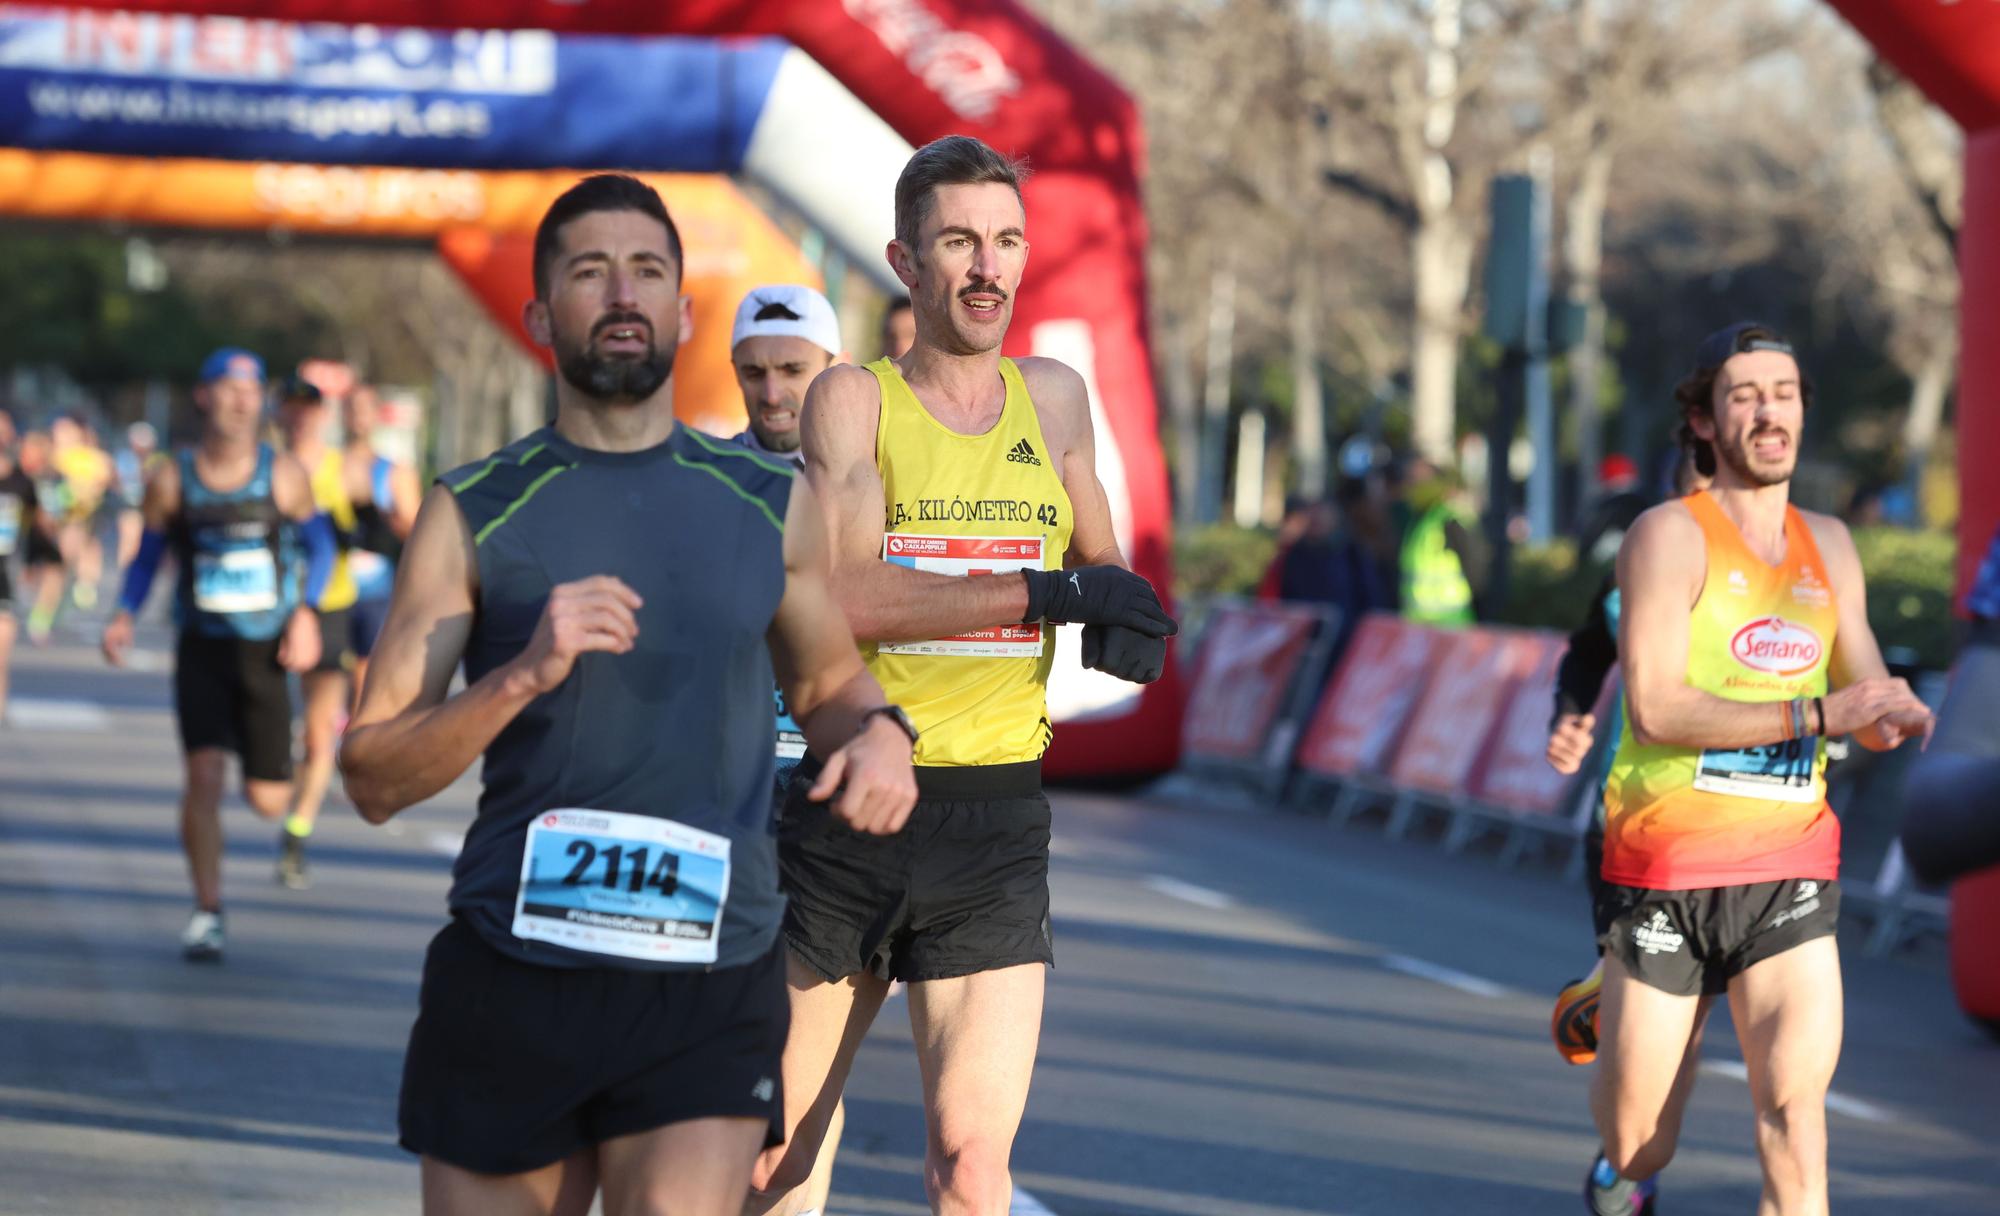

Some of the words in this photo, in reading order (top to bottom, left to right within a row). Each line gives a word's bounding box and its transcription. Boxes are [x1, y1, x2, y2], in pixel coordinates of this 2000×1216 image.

[1006, 453, 1041, 466] adidas
[885, 503, 911, 527] .A.
[918, 495, 1032, 522] KILÓMETRO
[1037, 503, 1058, 526] 42
[1743, 632, 1816, 661] Serrano
[562, 840, 680, 898] 2114
